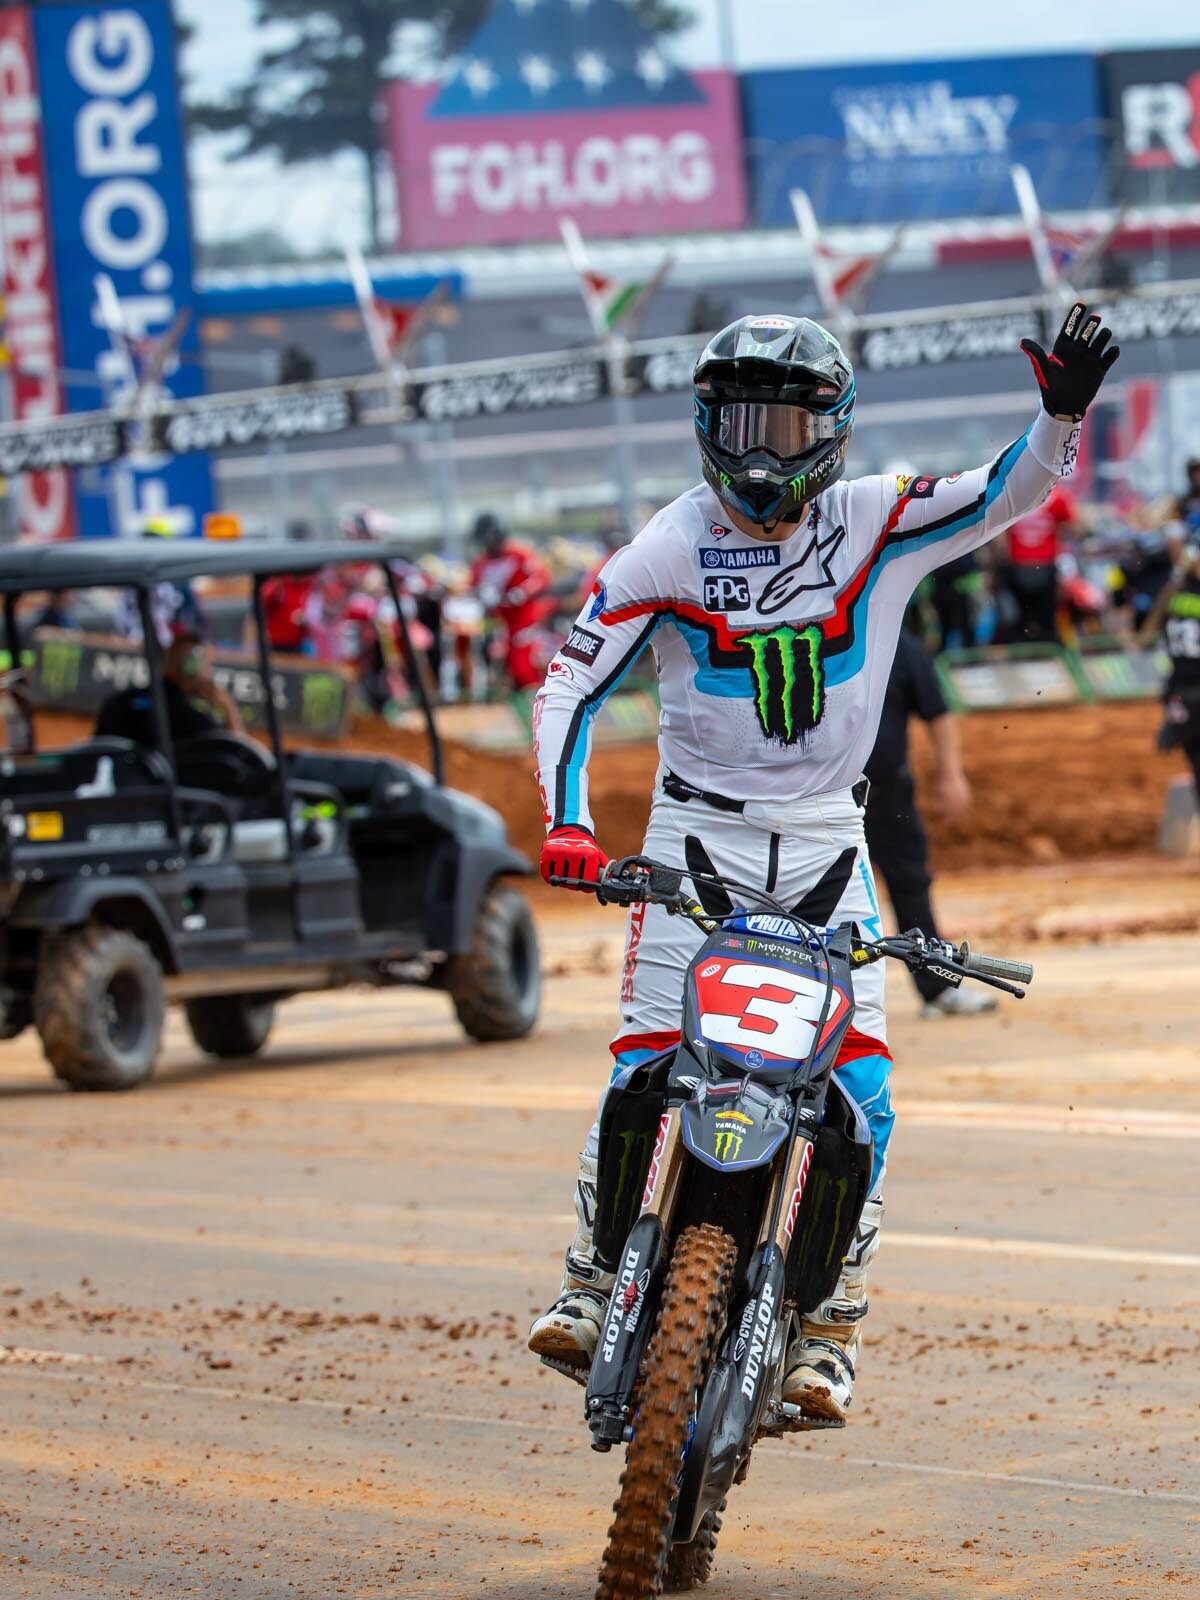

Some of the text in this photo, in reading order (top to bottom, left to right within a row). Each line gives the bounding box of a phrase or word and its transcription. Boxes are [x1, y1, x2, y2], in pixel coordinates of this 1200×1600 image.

[431, 130, 714, 214] FOH.ORG
[720, 549, 776, 567] YAMAHA
[705, 578, 749, 609] PPG
[758, 942, 813, 963] MONSTER
[700, 963, 843, 1060] 3
[714, 1122, 747, 1135] YAMAHA
[602, 1247, 641, 1363] DUNLOP
[738, 1298, 757, 1339] CYCRA
[741, 1282, 775, 1401] DUNLOP
